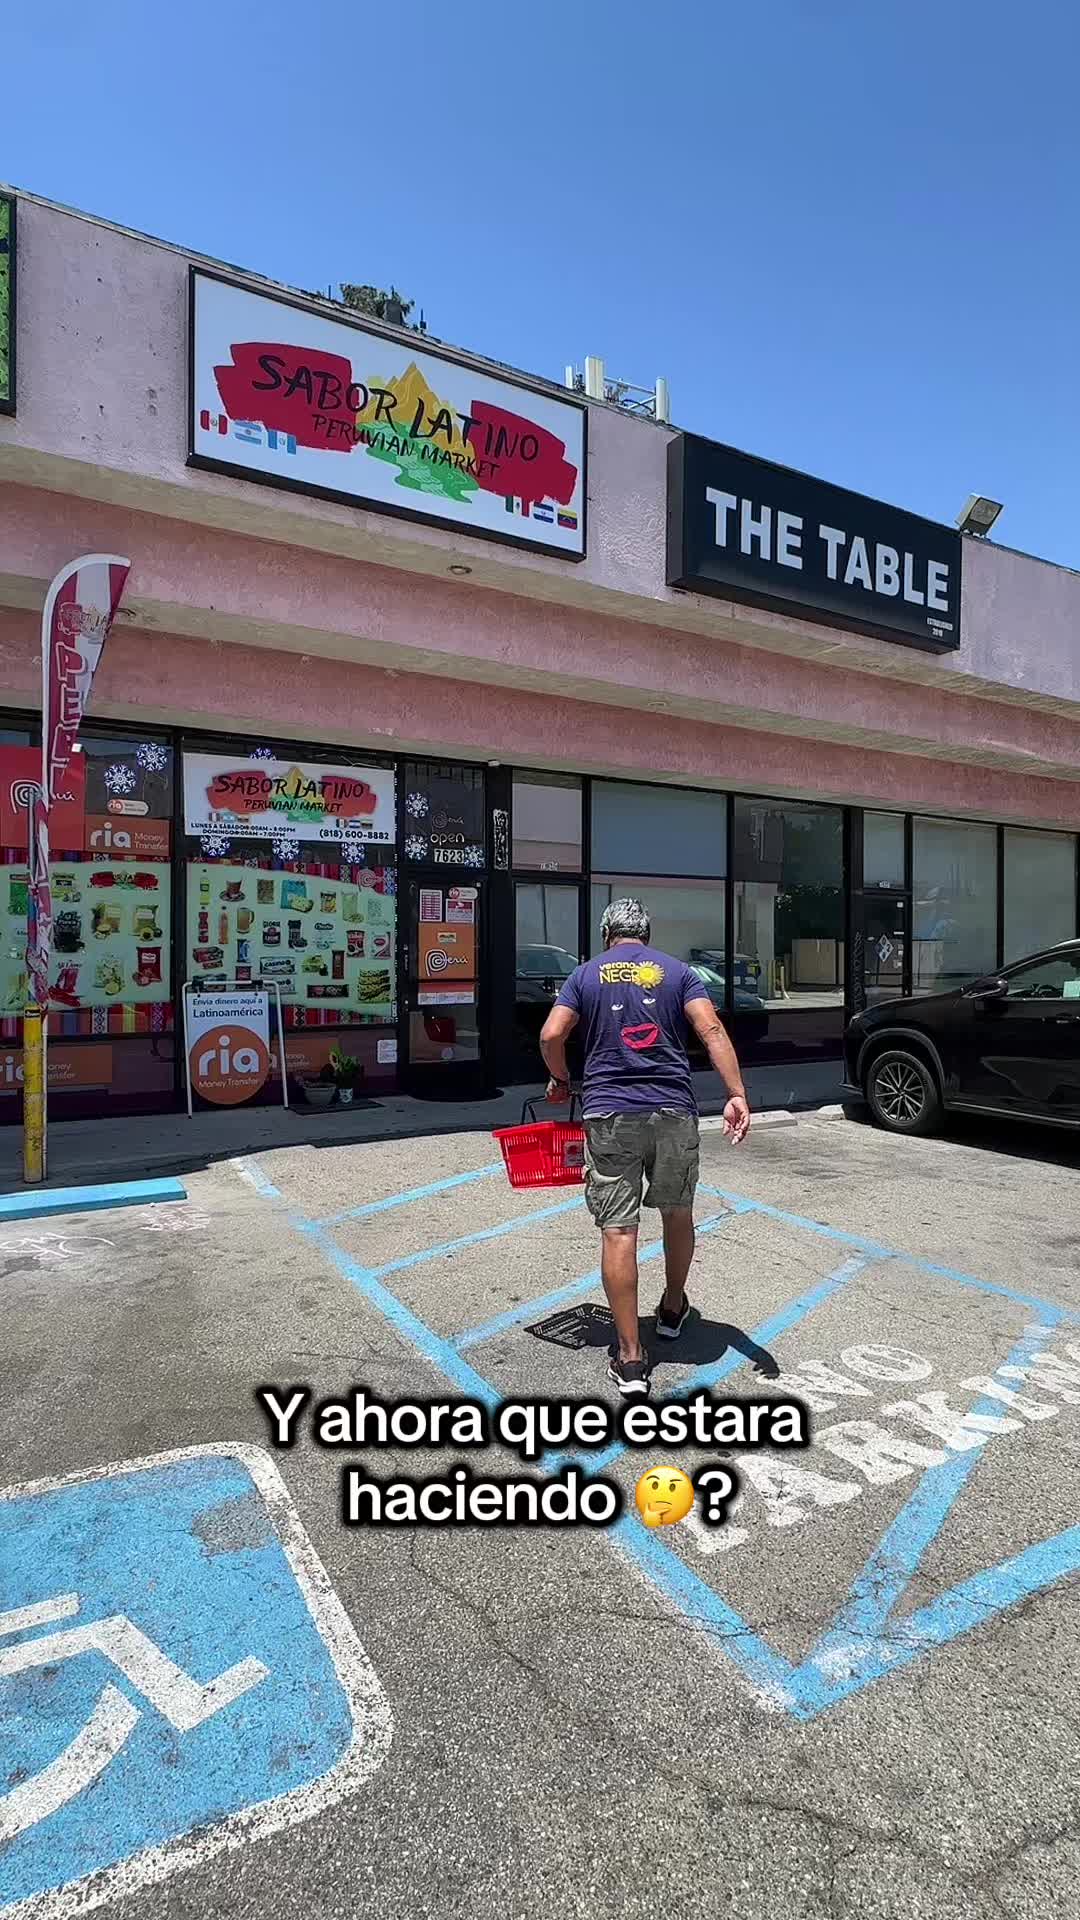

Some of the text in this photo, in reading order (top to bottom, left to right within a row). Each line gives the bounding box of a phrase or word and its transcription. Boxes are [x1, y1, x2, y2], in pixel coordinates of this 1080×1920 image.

[252, 355, 539, 462] SABOR LATINO
[312, 414, 501, 477] PERUVIAN MARKET
[706, 486, 949, 612] THE TABLE
[214, 775, 364, 799] SABOR LATINO
[243, 799, 343, 813] PERUVIAN MARKET
[90, 822, 131, 848] ria
[319, 828, 390, 840] (818) 600-8882
[430, 833, 465, 846] open
[435, 849, 464, 863] 7623
[425, 949, 468, 977] Perú
[599, 961, 636, 970] verano
[193, 1009, 264, 1018] Latinoamérica
[198, 1035, 260, 1076] ria
[199, 1080, 228, 1089] Money
